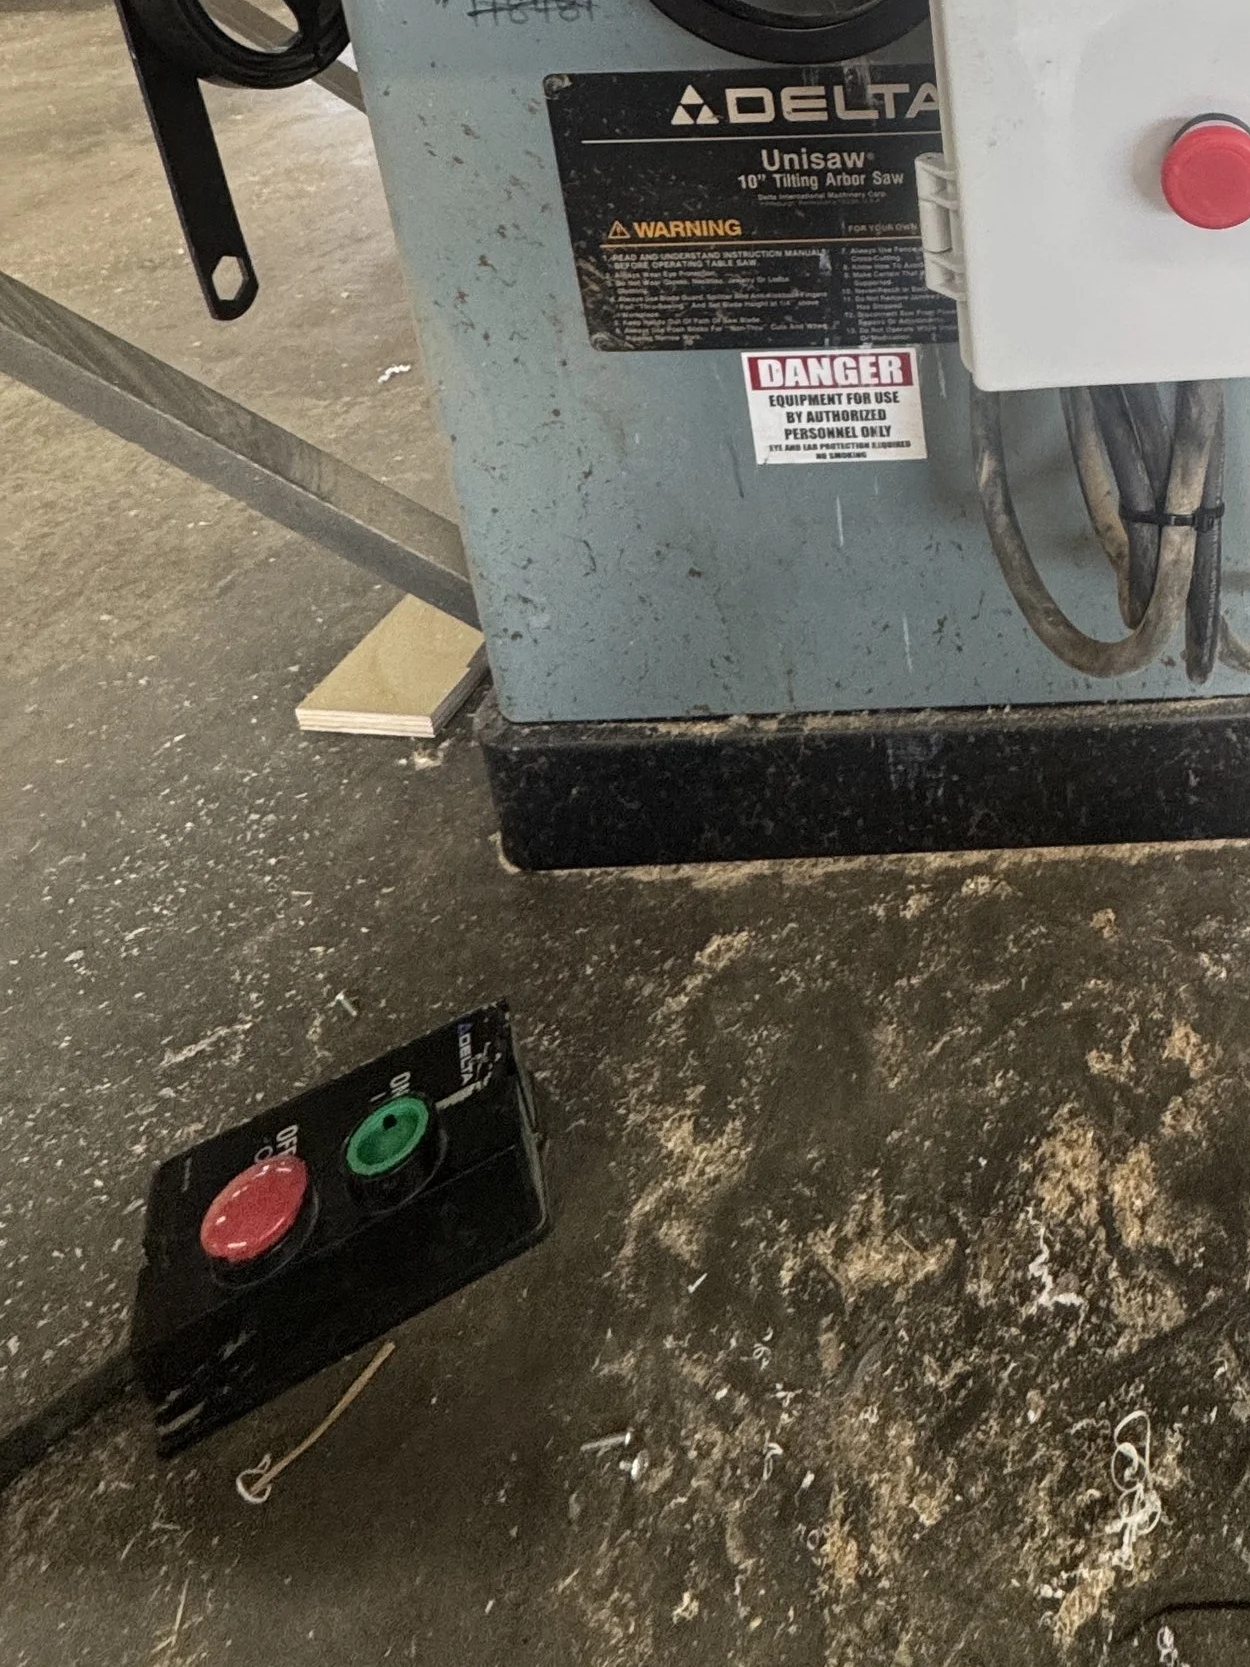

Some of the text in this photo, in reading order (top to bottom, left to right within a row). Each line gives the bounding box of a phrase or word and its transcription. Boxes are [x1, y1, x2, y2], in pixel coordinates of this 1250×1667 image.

[724, 83, 941, 124] DELTA
[760, 147, 865, 172] Unisaw
[772, 173, 818, 190] Tilting
[825, 172, 866, 187] Arbor
[872, 170, 904, 185] Saw
[632, 218, 743, 239] WARNING
[848, 222, 918, 233] FOR YOUR OWN
[611, 253, 638, 262] READ
[639, 253, 659, 261] AND
[660, 251, 721, 261] UNDERSTAND
[722, 250, 782, 259] INSTRUCTION
[614, 261, 649, 270] BEFORE
[651, 260, 704, 269] OPERATING
[705, 259, 734, 268] TABLE
[756, 355, 904, 388] DANGER
[768, 390, 900, 408] EQUIPMENT FOR USE
[785, 408, 887, 424] BY AUTHORIZED
[784, 425, 892, 441] PERSONNEL ONLY
[768, 440, 911, 452] EYE AND EAR PROTECTION REQUIRED
[815, 451, 868, 460] NO SMOKING
[458, 1032, 474, 1087] DELTA
[389, 1070, 412, 1099] ON
[275, 1123, 299, 1156] OFF
